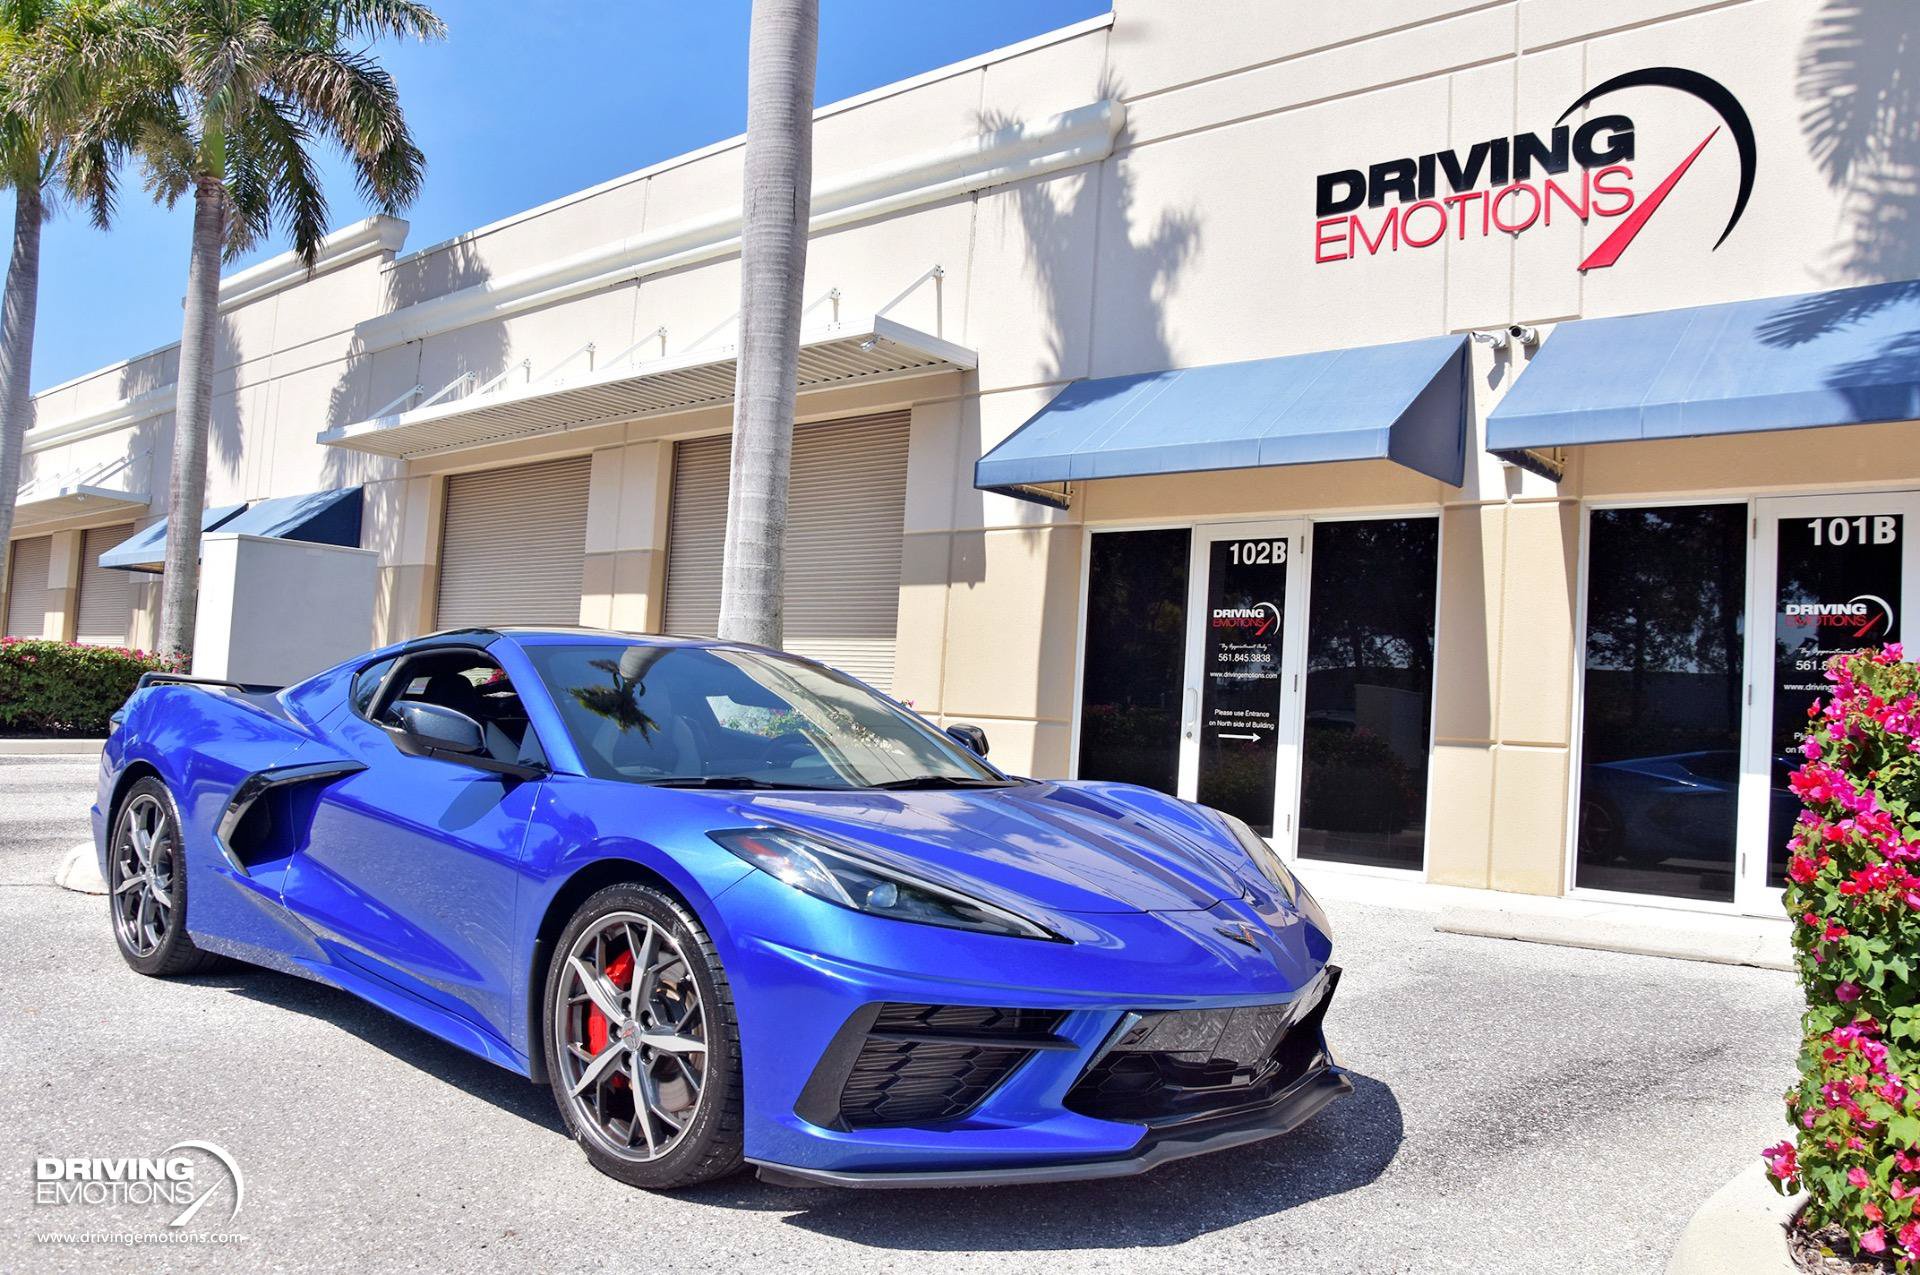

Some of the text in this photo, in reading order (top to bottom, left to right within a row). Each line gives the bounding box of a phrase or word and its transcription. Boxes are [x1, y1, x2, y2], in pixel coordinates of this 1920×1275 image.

[1316, 114, 1635, 217] DRIVING
[1315, 165, 1636, 264] EMOTIONS
[1808, 516, 1896, 546] 101B
[1229, 541, 1287, 565] 102B
[1213, 609, 1265, 618] DRIVING
[1786, 603, 1867, 615] DRIVING
[1212, 618, 1265, 628] EMOTIONS
[1785, 615, 1867, 627] EMOTIONS
[1218, 653, 1271, 662] 561.845.3838
[1209, 671, 1278, 679] www.drivingemotions.com
[1214, 708, 1233, 716] Please
[1245, 709, 1270, 718] Entrance
[1252, 721, 1275, 730] Building
